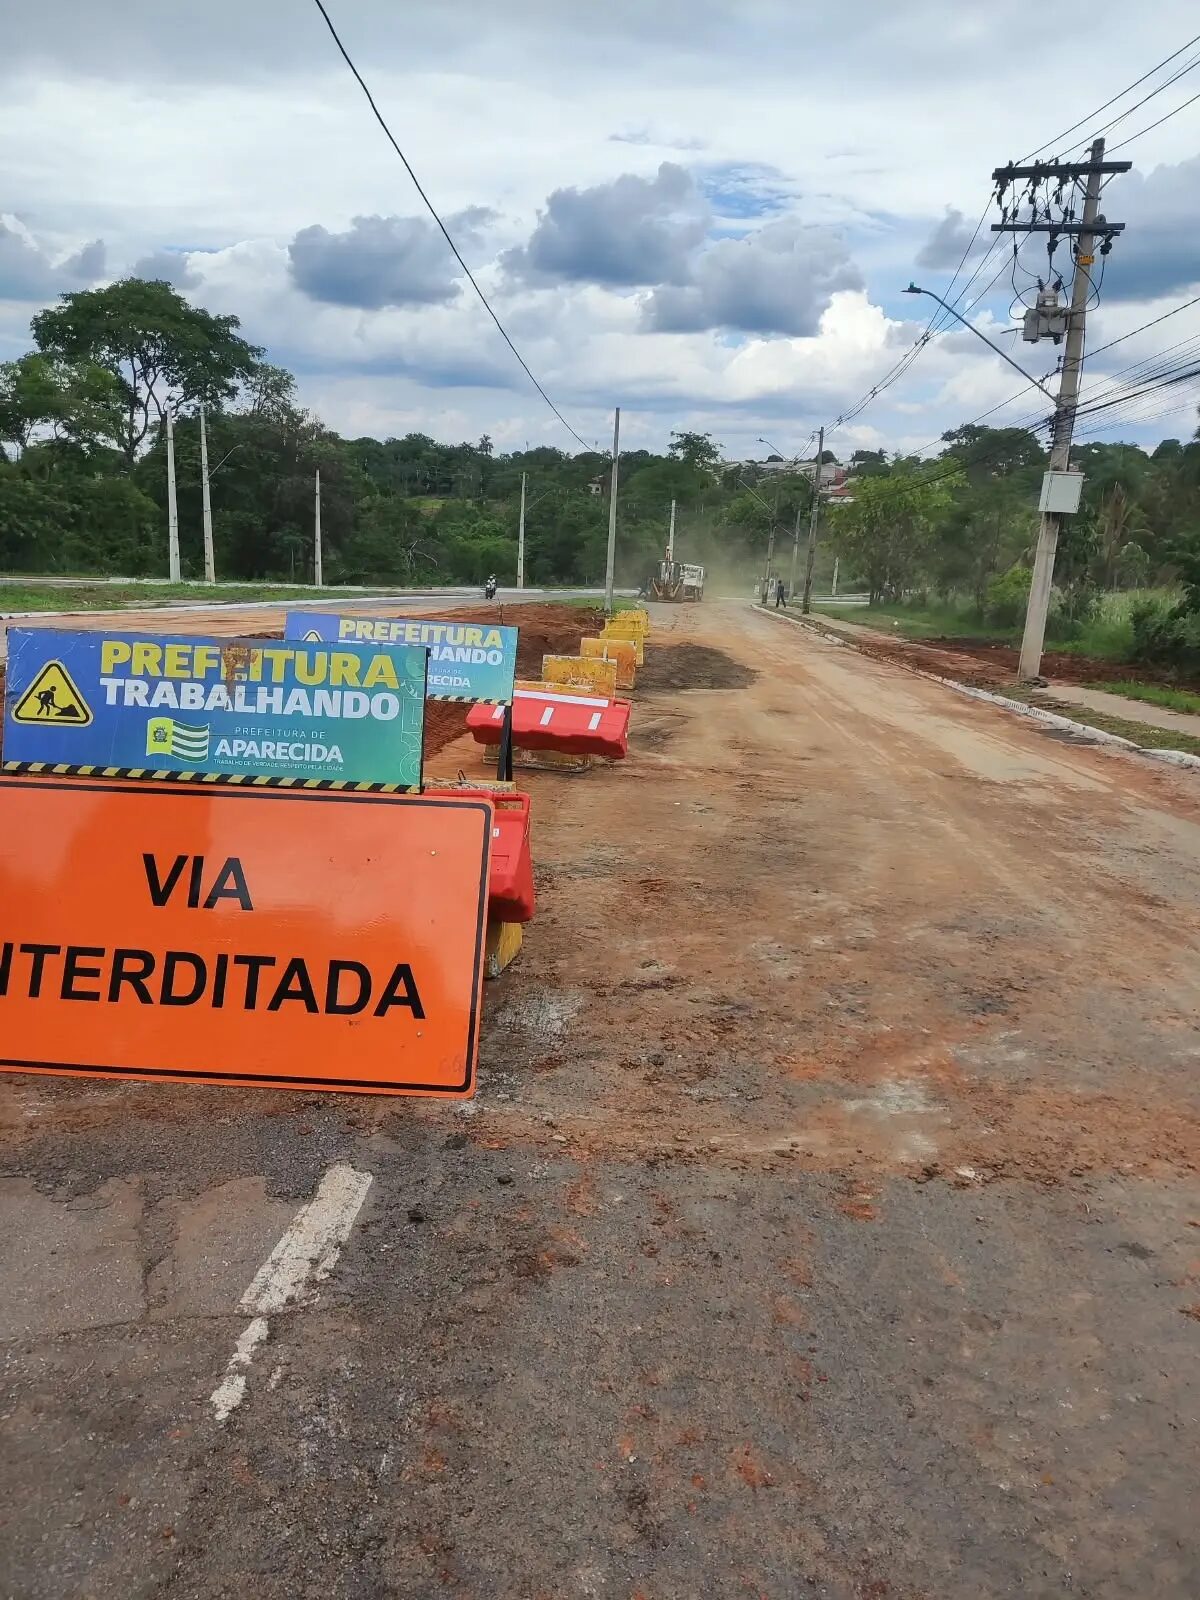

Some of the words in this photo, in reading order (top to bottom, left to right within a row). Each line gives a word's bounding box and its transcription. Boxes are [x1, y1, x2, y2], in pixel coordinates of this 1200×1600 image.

[338, 619, 503, 648] PREFEITURA
[427, 675, 471, 688] RECIDA
[99, 678, 400, 720] TRABALHANDO
[235, 727, 307, 738] PREFEITURA
[311, 731, 326, 739] DE
[214, 738, 344, 763] APARECIDA
[142, 853, 254, 911] VIA
[0, 942, 426, 1019] TERDITADA
